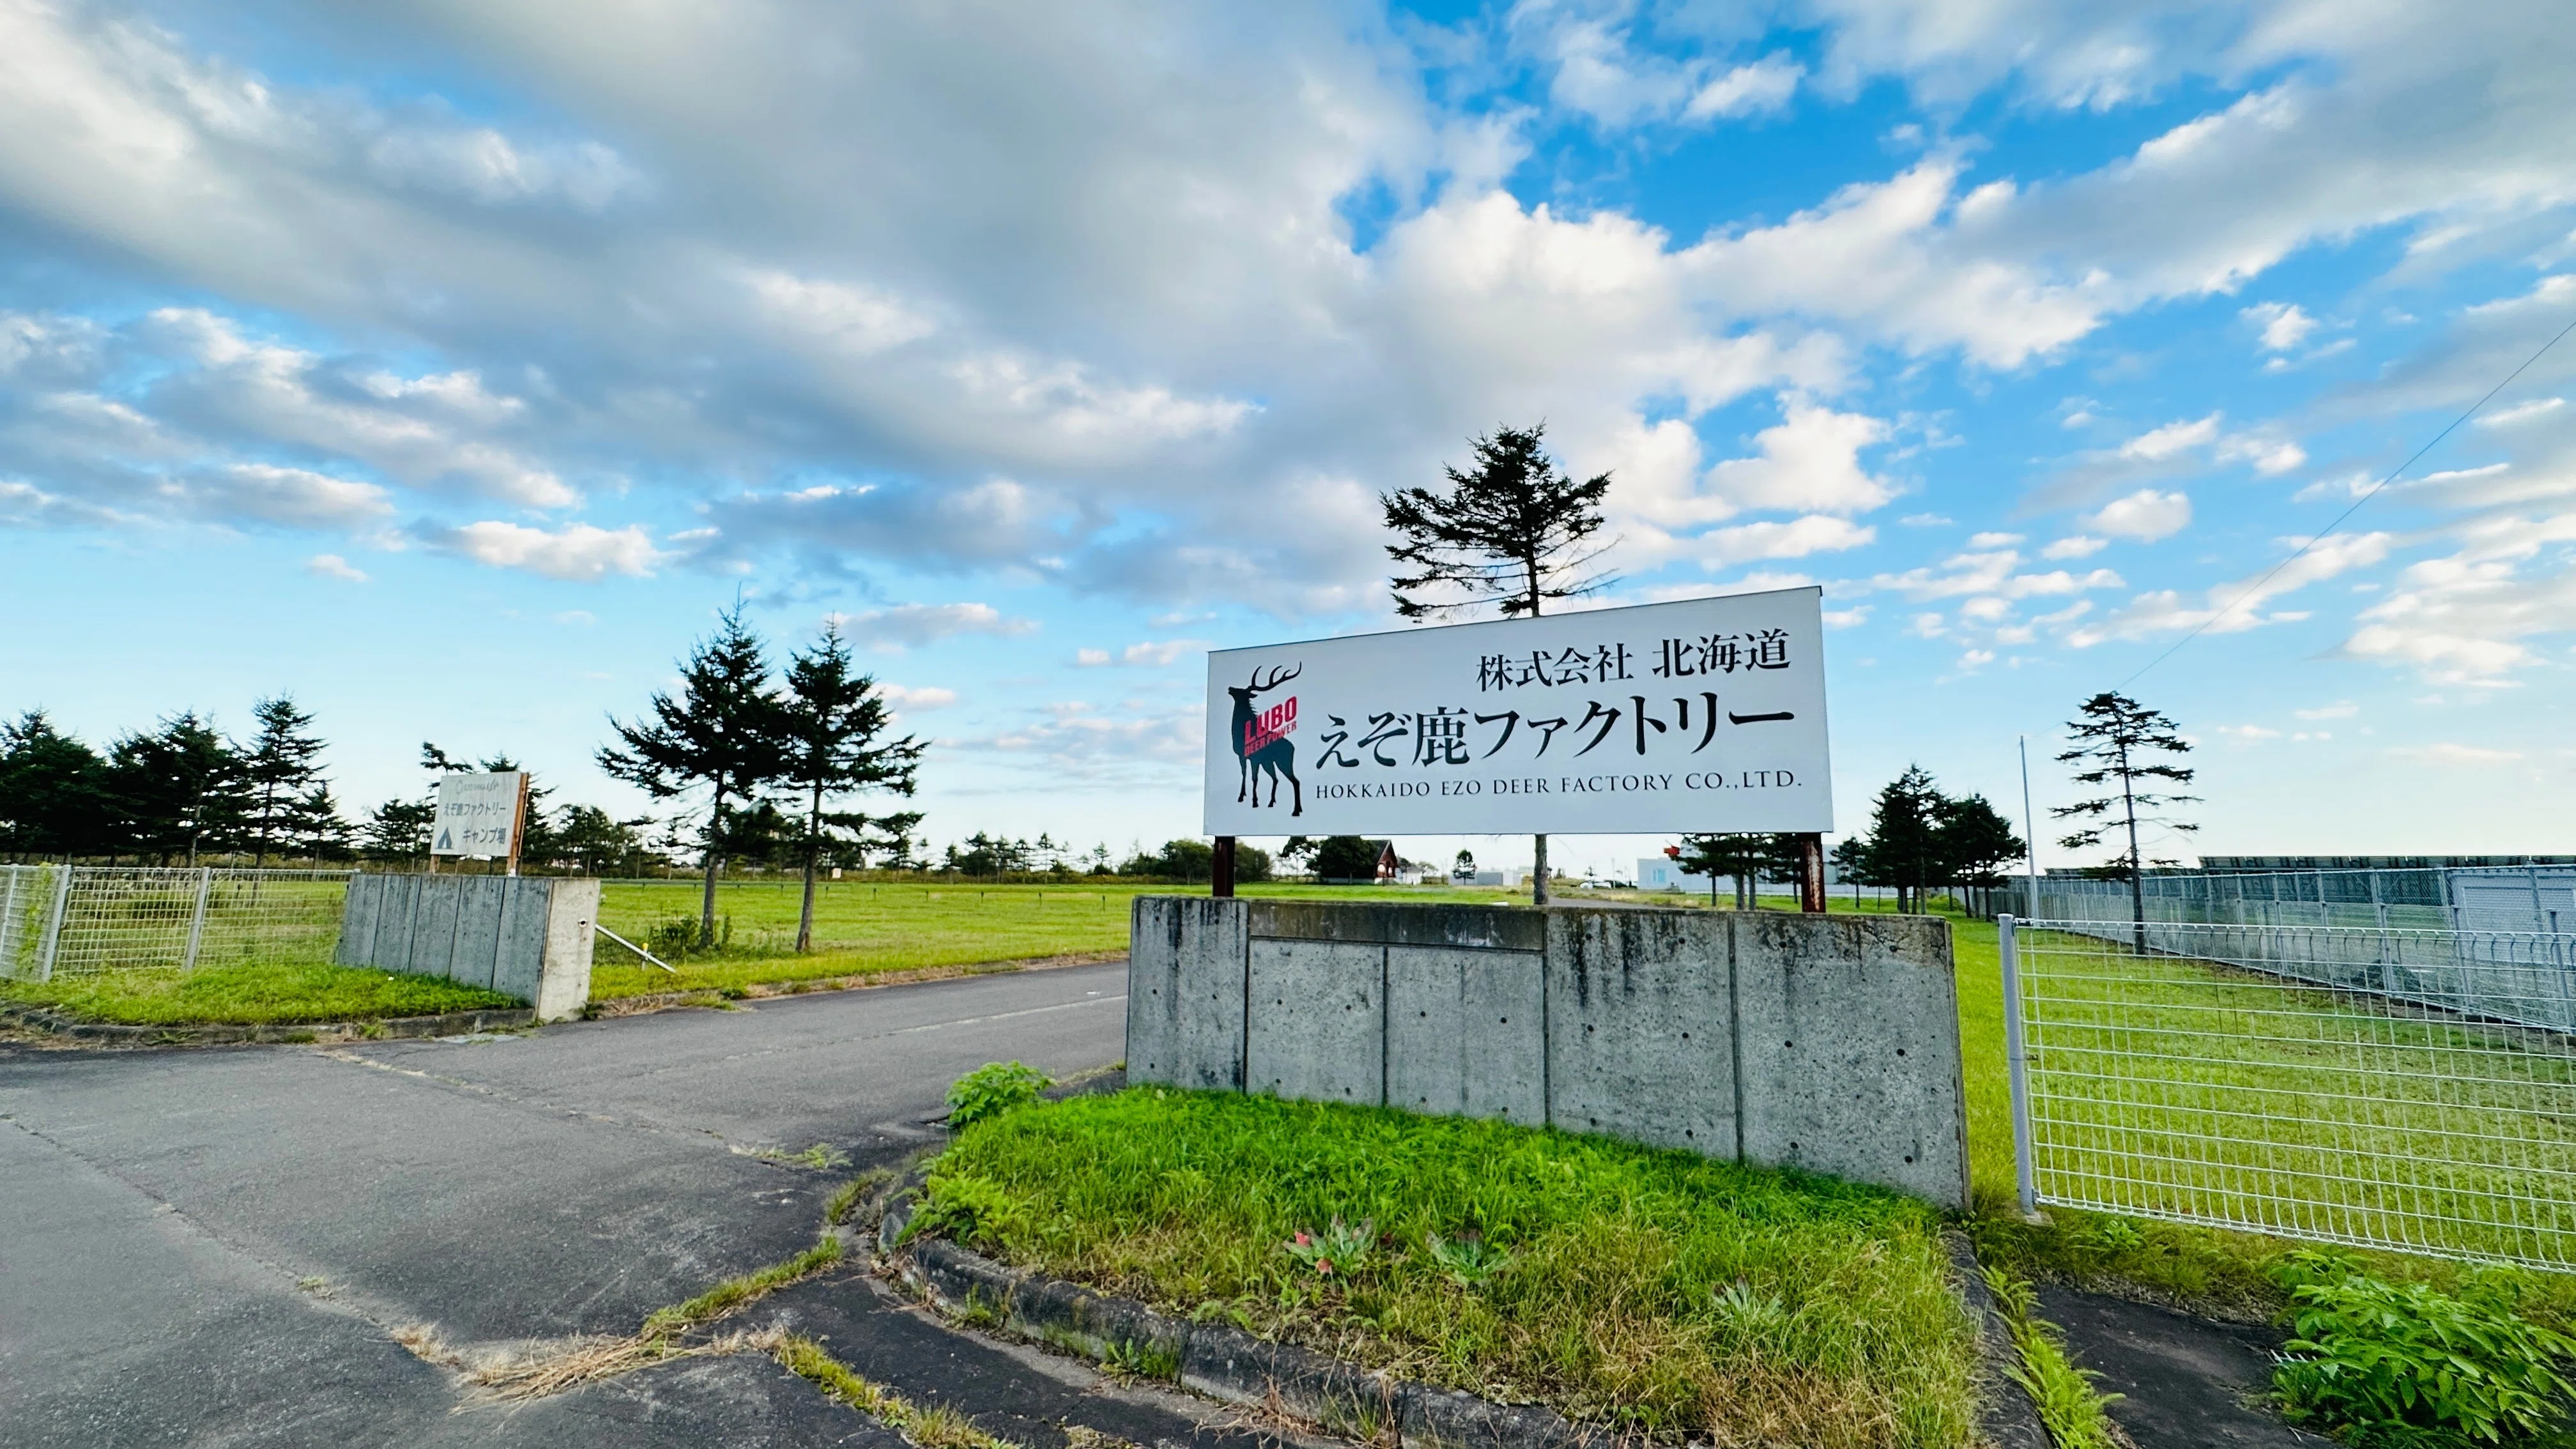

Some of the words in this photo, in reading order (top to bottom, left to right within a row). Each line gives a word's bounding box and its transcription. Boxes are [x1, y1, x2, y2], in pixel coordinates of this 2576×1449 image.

[1476, 643, 1634, 692] 株式会社
[1652, 628, 1791, 678] 北海道
[1245, 696, 1297, 746] LUBO
[1316, 692, 1795, 770] えぞ鹿ファクトリー
[1316, 782, 1430, 799] HOKKAIDO
[1441, 781, 1482, 796] EZO
[1493, 778, 1549, 794] DEER
[1561, 774, 1672, 792] FACTORY
[463, 827, 507, 844] キャンプ場
